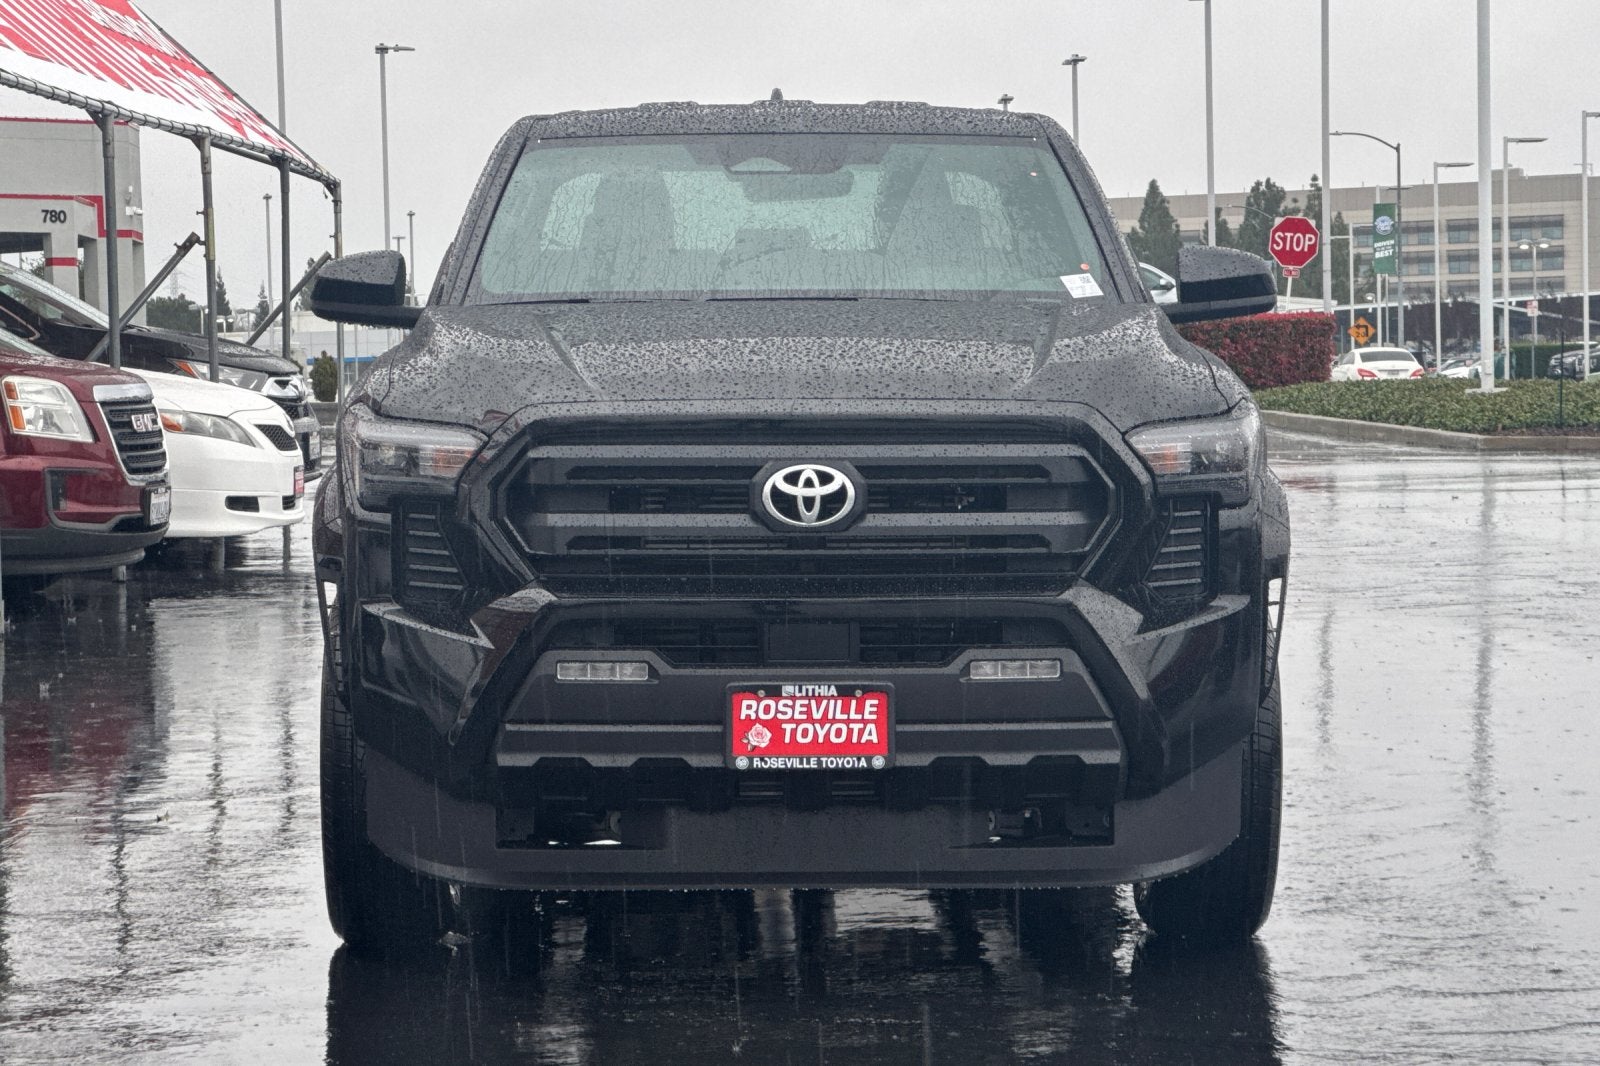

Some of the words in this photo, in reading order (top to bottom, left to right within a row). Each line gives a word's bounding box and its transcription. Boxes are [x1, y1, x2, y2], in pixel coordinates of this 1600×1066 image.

[41, 209, 67, 224] 780
[1273, 232, 1316, 252] STOP
[1375, 249, 1394, 258] BEST
[131, 413, 159, 432] GMC
[794, 685, 838, 697] LITHIA
[739, 699, 880, 720] ROSEVILLE
[781, 723, 880, 744] TOYOTA
[753, 757, 818, 768] ROSEVILLE
